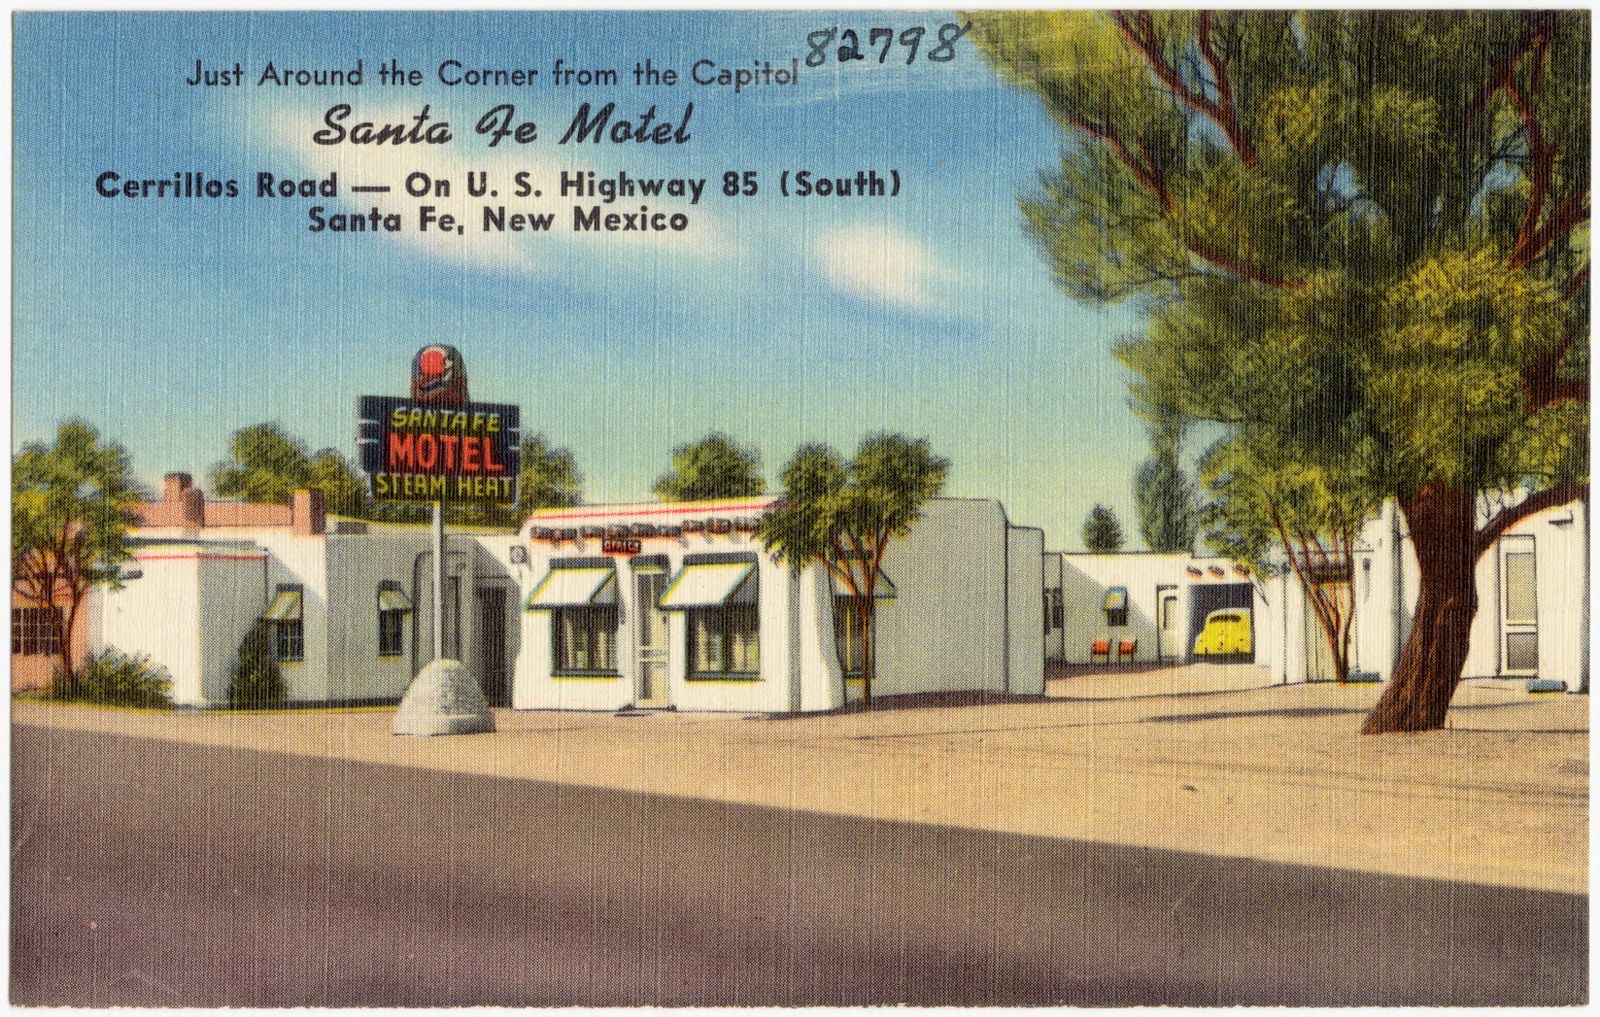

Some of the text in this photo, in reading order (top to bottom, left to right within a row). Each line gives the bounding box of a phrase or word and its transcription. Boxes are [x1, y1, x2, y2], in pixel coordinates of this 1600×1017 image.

[805, 21, 972, 68] 82798
[391, 407, 501, 432] SANTA FE
[388, 432, 504, 471] MOTEL
[375, 473, 513, 497] STEAM HEAT
